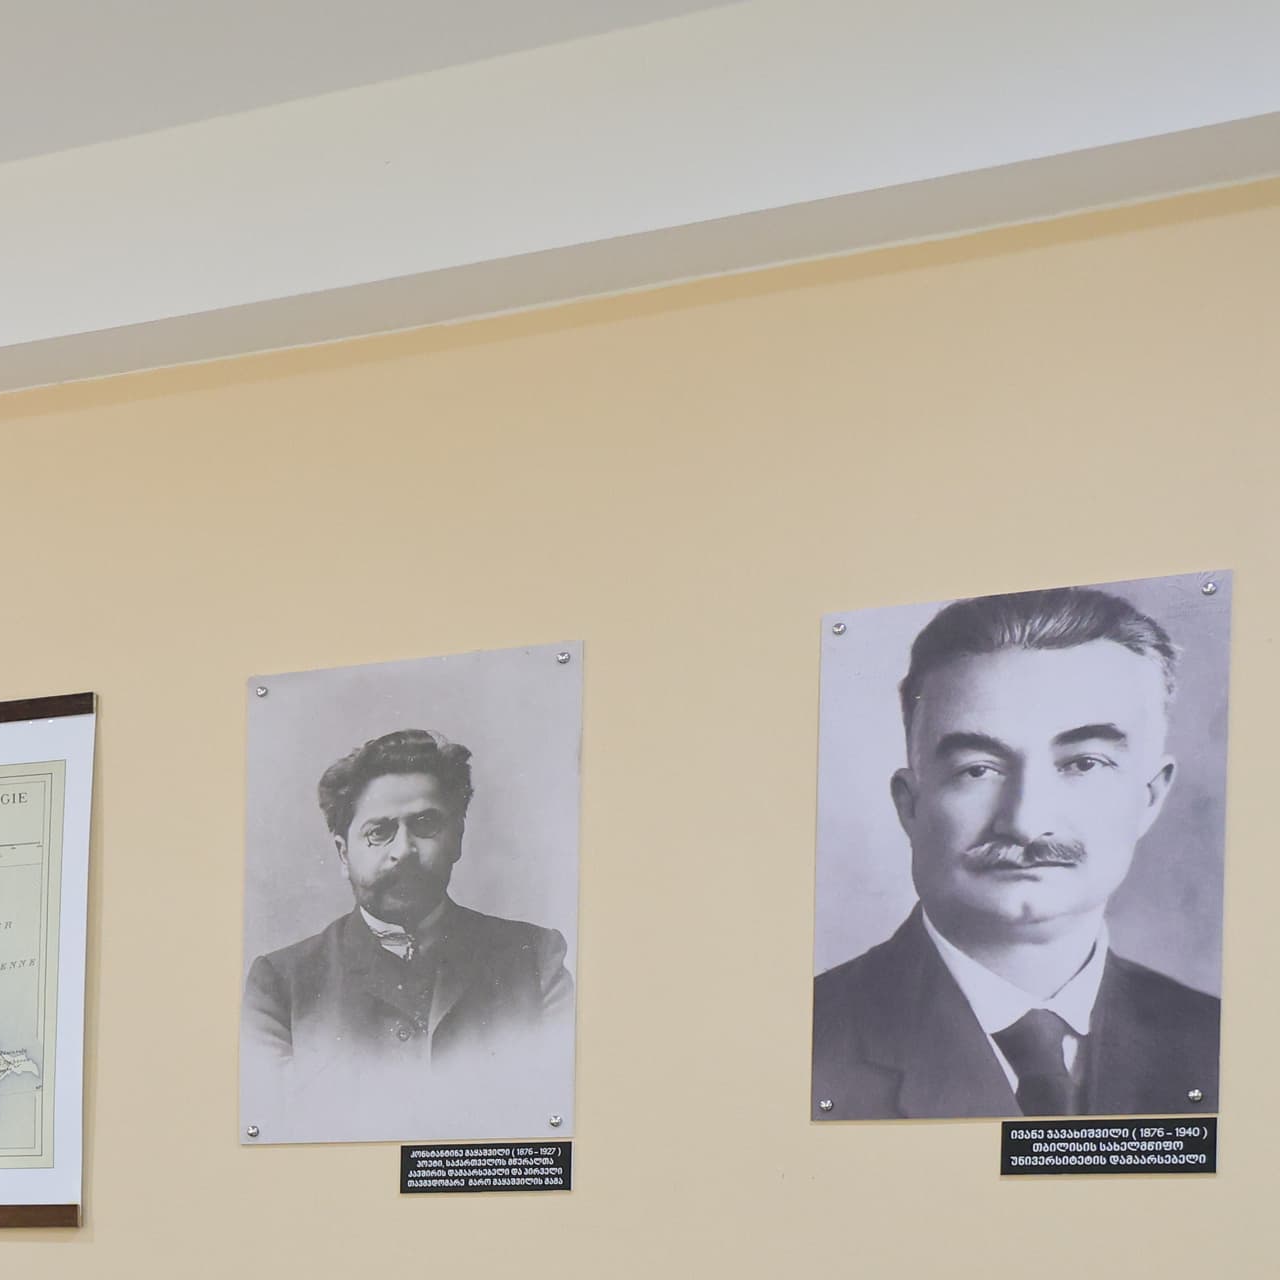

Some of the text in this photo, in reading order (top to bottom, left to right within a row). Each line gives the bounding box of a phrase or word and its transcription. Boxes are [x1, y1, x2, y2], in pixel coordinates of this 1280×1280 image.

[1011, 1129, 1044, 1140] ივანე
[1046, 1128, 1129, 1140] ჯავახიშვილი
[1140, 1127, 1165, 1138] 1876
[1175, 1127, 1200, 1137] 1940
[410, 1149, 464, 1159] კონსტანტინე
[465, 1148, 510, 1158] მაყაშვილი
[517, 1148, 533, 1156] 1876
[539, 1147, 556, 1156] 1927
[1032, 1141, 1184, 1153] თბილისის სახელმწიფო
[446, 1158, 507, 1167] საქართველოს
[508, 1157, 554, 1166] მწერალთა
[1010, 1154, 1207, 1167] უნივერსიტეტის დამაარსებელი
[447, 1168, 509, 1178] დამაარსებელი
[511, 1167, 523, 1176] და
[524, 1167, 563, 1176] პირველი
